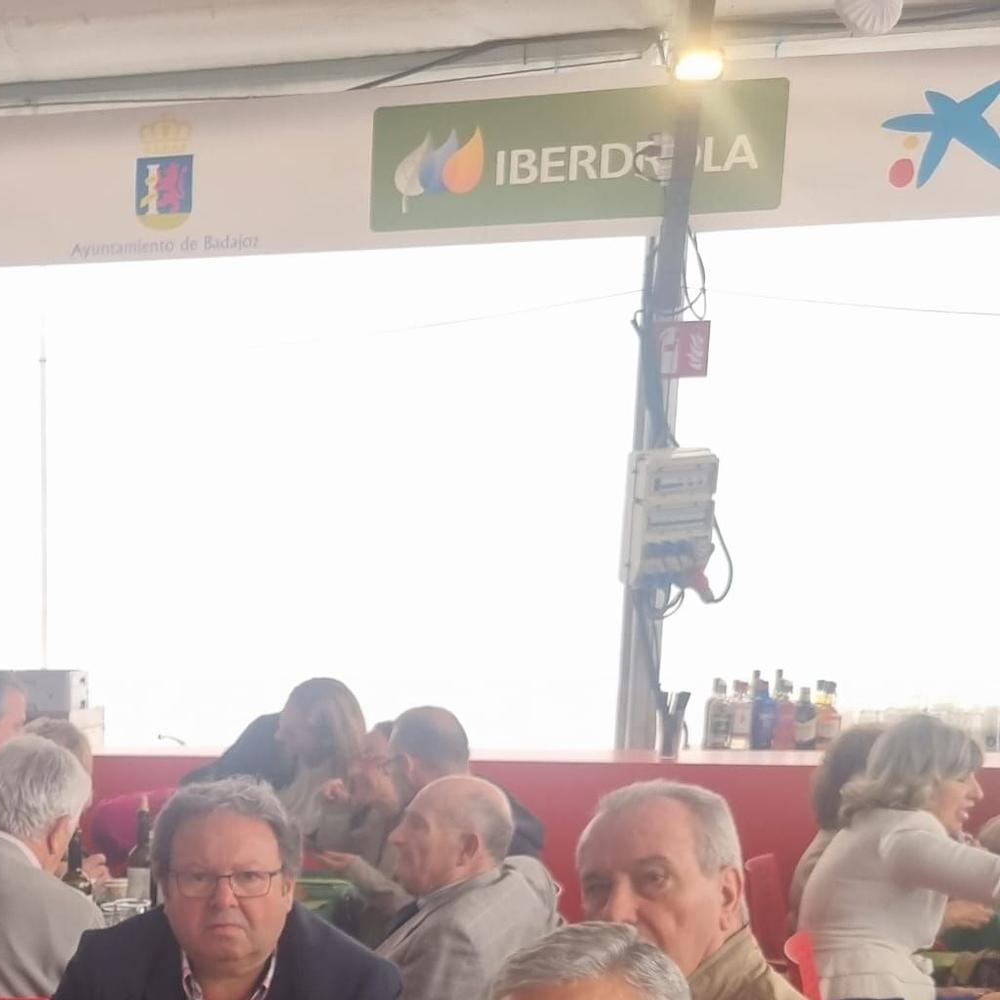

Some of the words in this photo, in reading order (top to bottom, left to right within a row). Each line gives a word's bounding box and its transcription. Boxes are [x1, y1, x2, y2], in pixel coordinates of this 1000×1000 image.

[496, 133, 759, 186] IBERDRLA
[71, 238, 175, 258] Ayuntamiento
[180, 236, 198, 250] de
[203, 233, 259, 250] Badajoz
